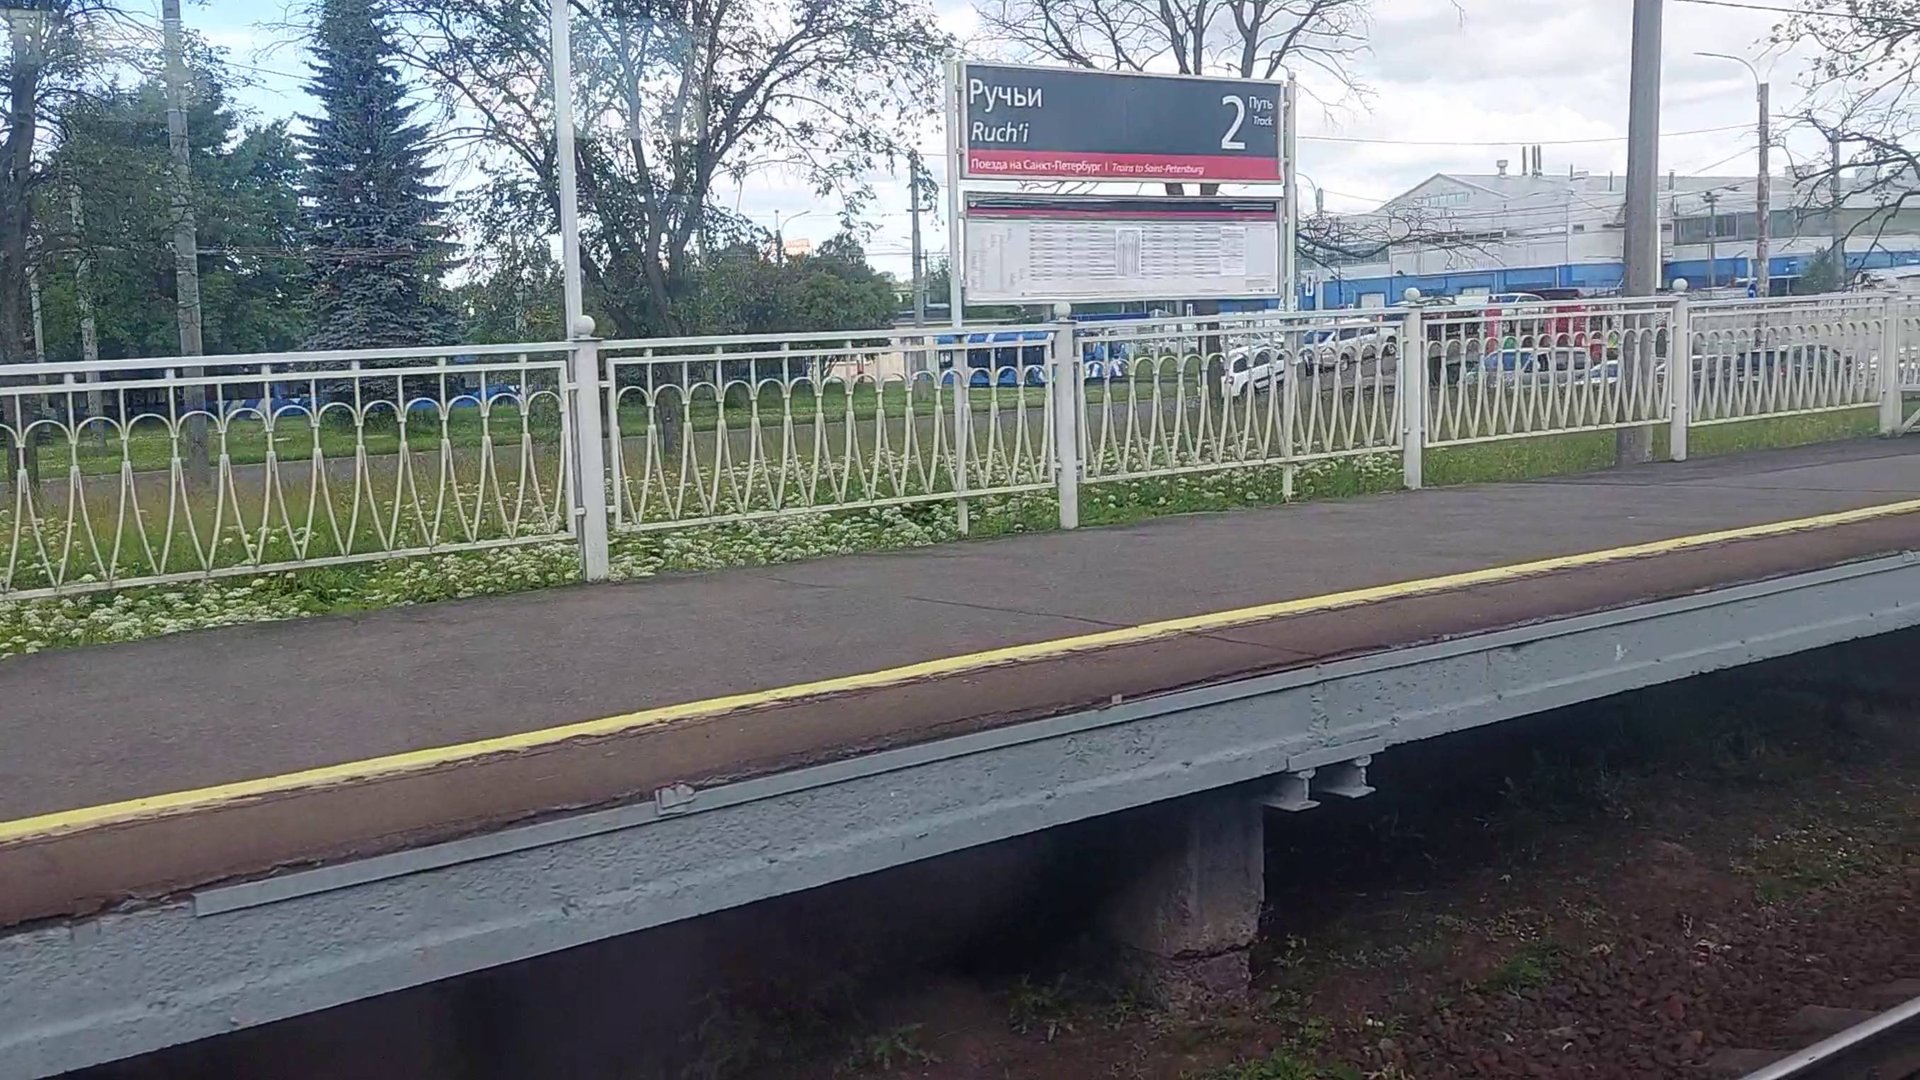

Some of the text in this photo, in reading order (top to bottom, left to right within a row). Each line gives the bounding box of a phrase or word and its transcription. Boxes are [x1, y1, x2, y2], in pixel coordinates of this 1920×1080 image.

[969, 78, 1042, 113] Ручьи
[1248, 96, 1274, 113] Путь
[1221, 95, 1246, 150] 2
[1253, 116, 1273, 126] Track
[971, 158, 1102, 175] Поезда на Санкт-Петербург
[1112, 163, 1205, 176] Trains to Saint-Petersburg
